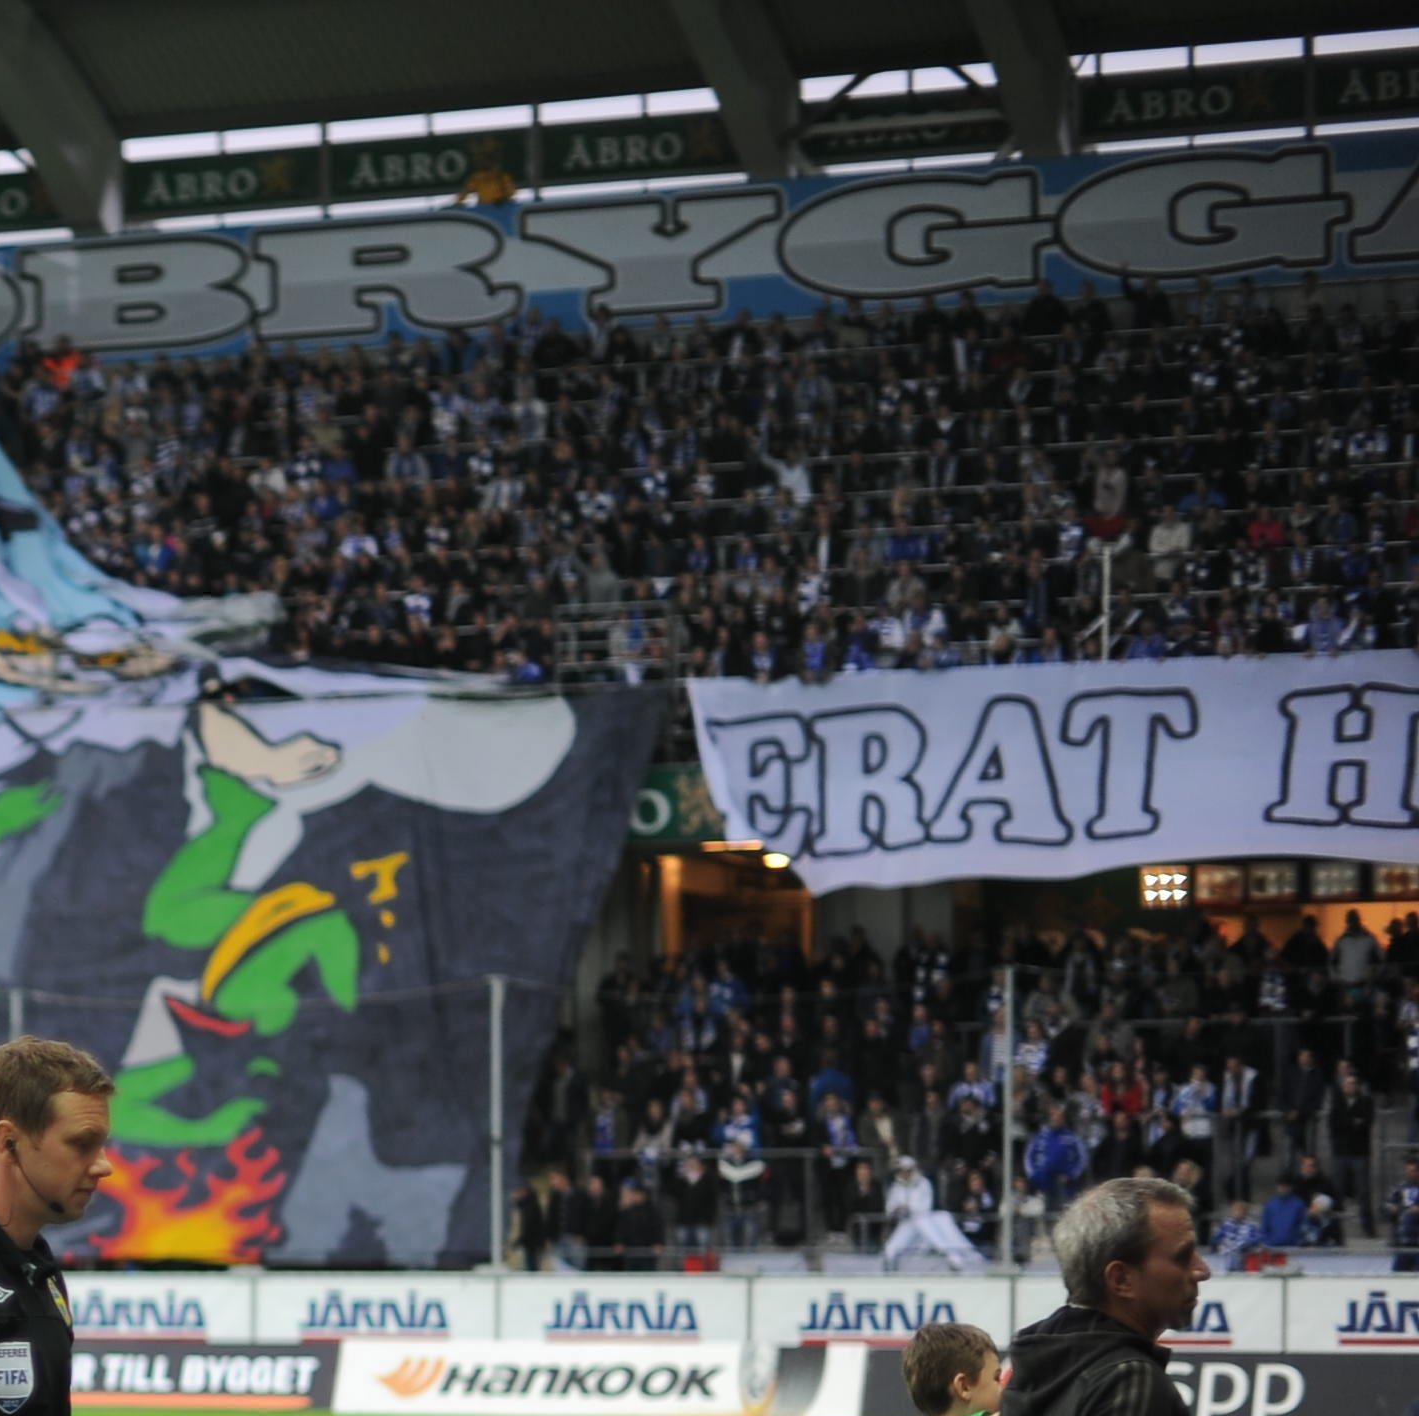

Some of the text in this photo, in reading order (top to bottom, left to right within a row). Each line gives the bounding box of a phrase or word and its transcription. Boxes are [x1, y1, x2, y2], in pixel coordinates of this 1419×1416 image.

[1265, 681, 1419, 828] H
[300, 1289, 449, 1329] JÄRNIA
[545, 1291, 699, 1332] JÄRNIA
[800, 1291, 956, 1332] JÄRNIA
[101, 1354, 175, 1392] TILL
[179, 1355, 320, 1394] BYGGET
